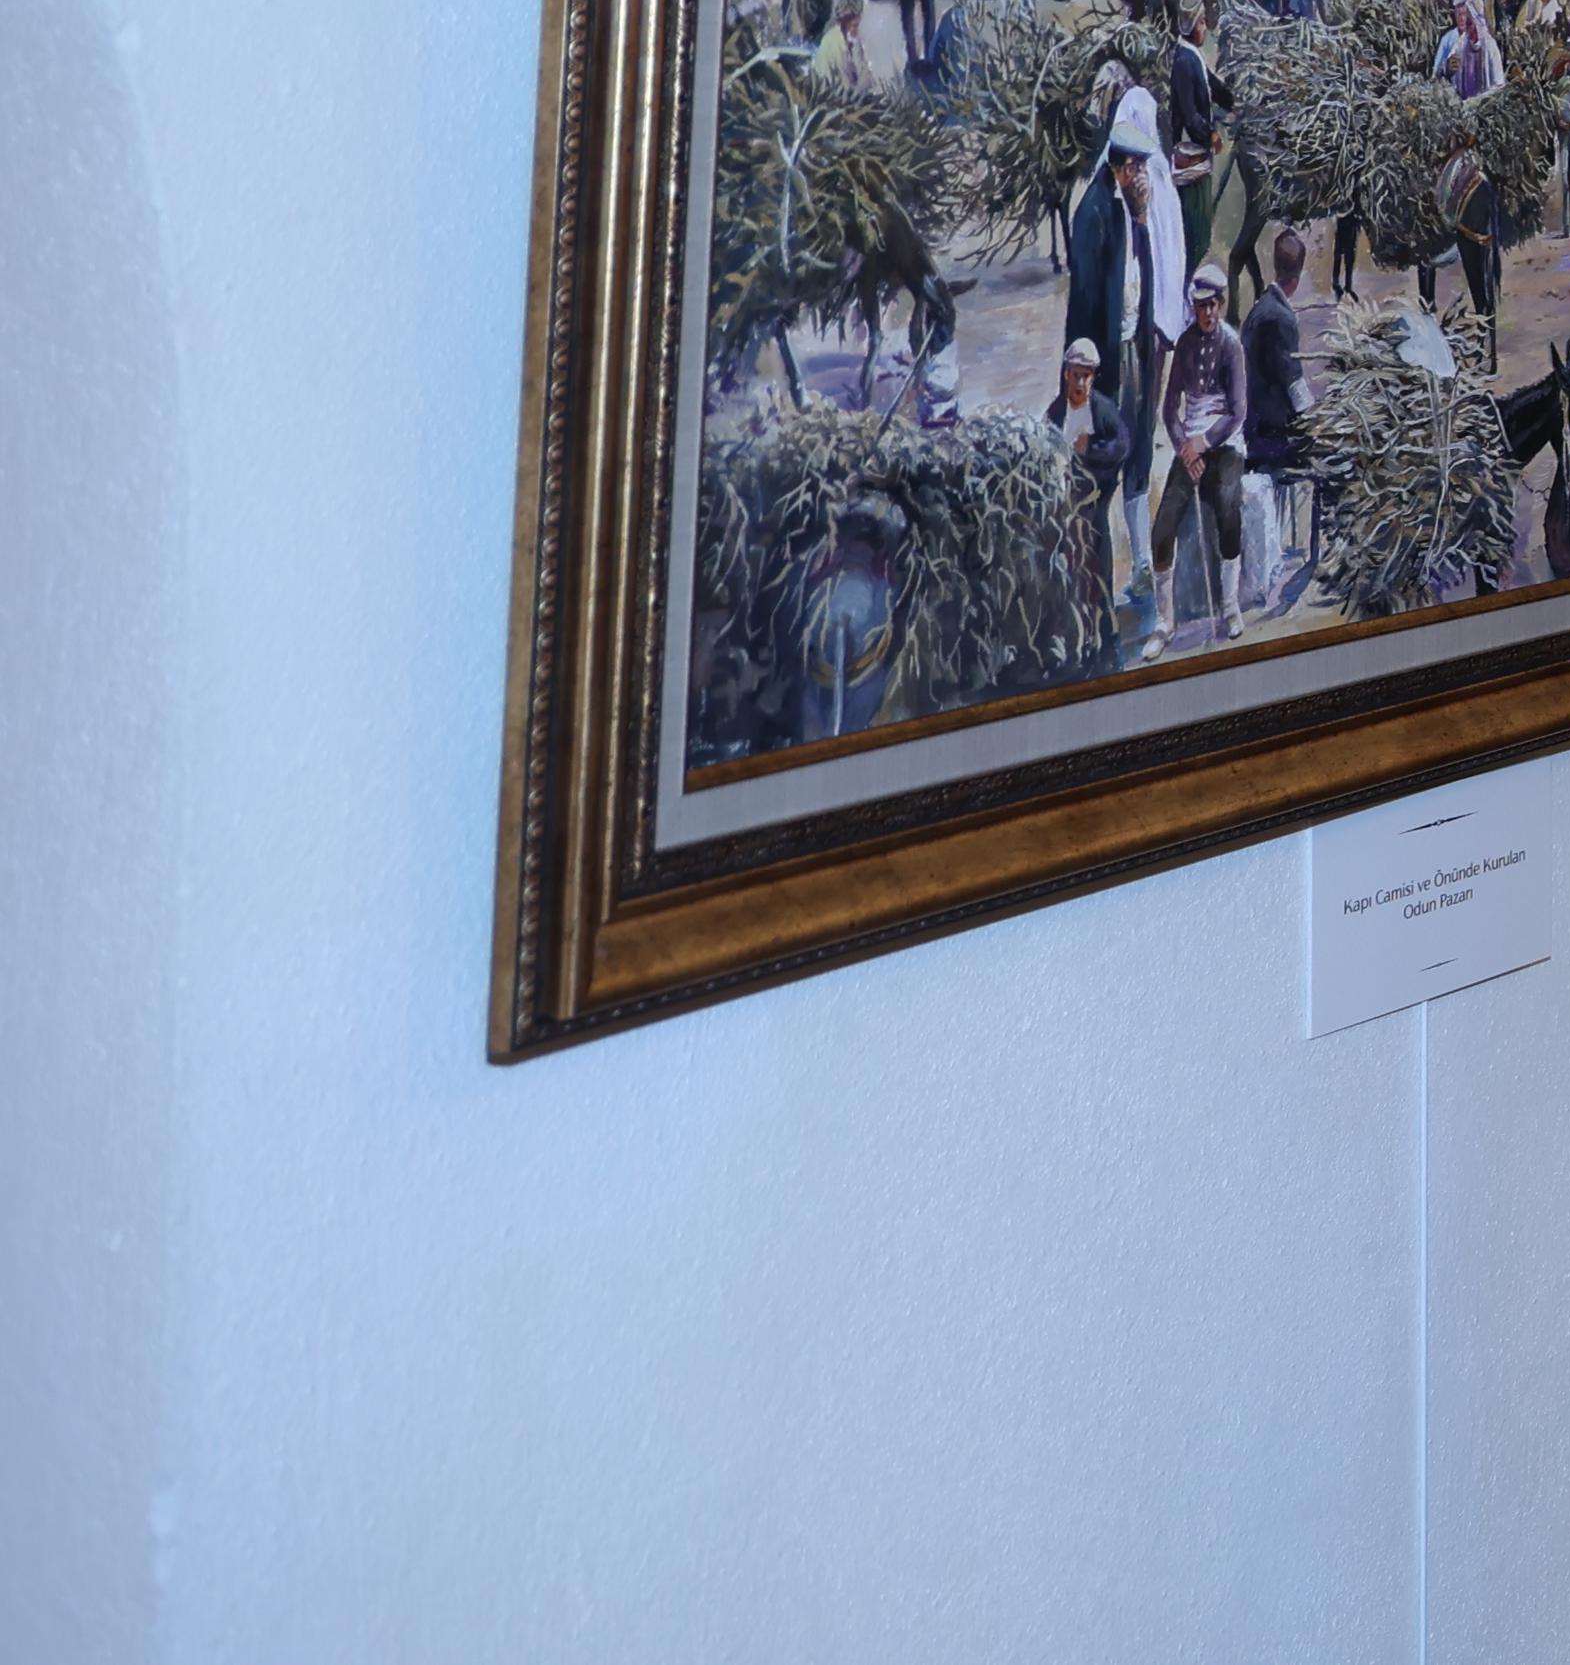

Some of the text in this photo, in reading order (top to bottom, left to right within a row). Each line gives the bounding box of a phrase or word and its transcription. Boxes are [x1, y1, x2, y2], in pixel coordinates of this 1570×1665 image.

[1343, 850, 1526, 915] Kapı Camisi ve Önünde Kurulan
[1403, 888, 1473, 919] Odun Pazarı
